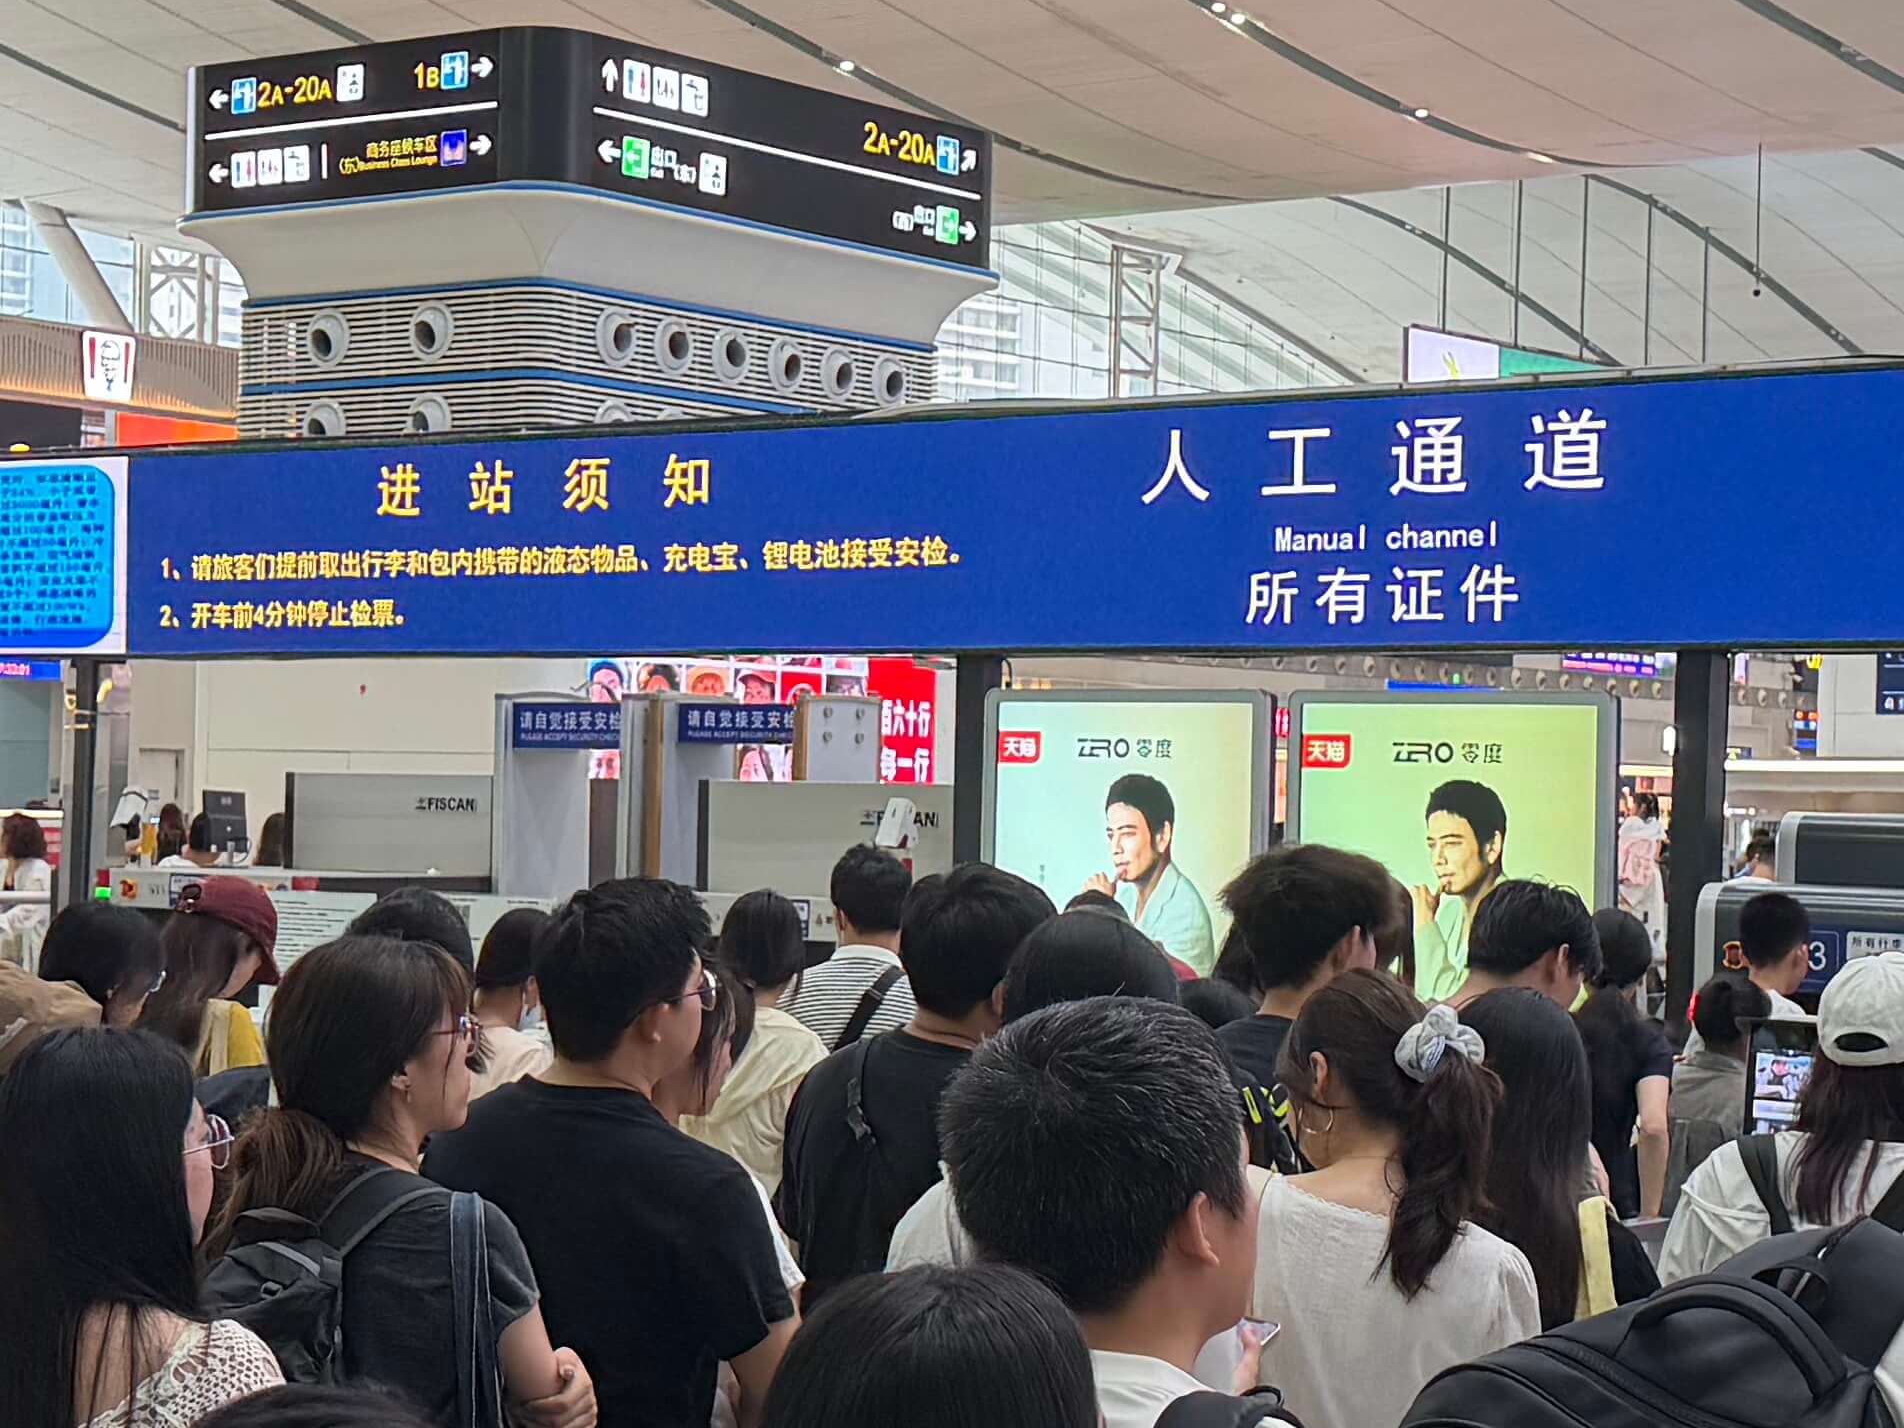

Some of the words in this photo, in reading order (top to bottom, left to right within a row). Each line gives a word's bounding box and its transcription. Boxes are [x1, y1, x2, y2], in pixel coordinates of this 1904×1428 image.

[257, 75, 333, 108] 2A-20A
[414, 62, 440, 90] 1B
[863, 121, 935, 167] 2A-20A
[1141, 408, 1608, 506] 人工通道
[376, 452, 711, 517] 进站须知
[1274, 524, 1367, 553] Manual
[1385, 520, 1497, 550] channel
[1244, 563, 1520, 626] 所有证件
[159, 598, 405, 631] 2、开车前4分钟停止检票。
[1003, 736, 1037, 757] 天猫
[1077, 738, 1130, 758] ZERO
[1137, 738, 1172, 759] 零度
[1306, 740, 1345, 762] 天猫
[1392, 741, 1454, 764] ZERO
[1461, 742, 1503, 764] 零度
[427, 796, 474, 812] FISCAN
[1808, 940, 1827, 971] 3
